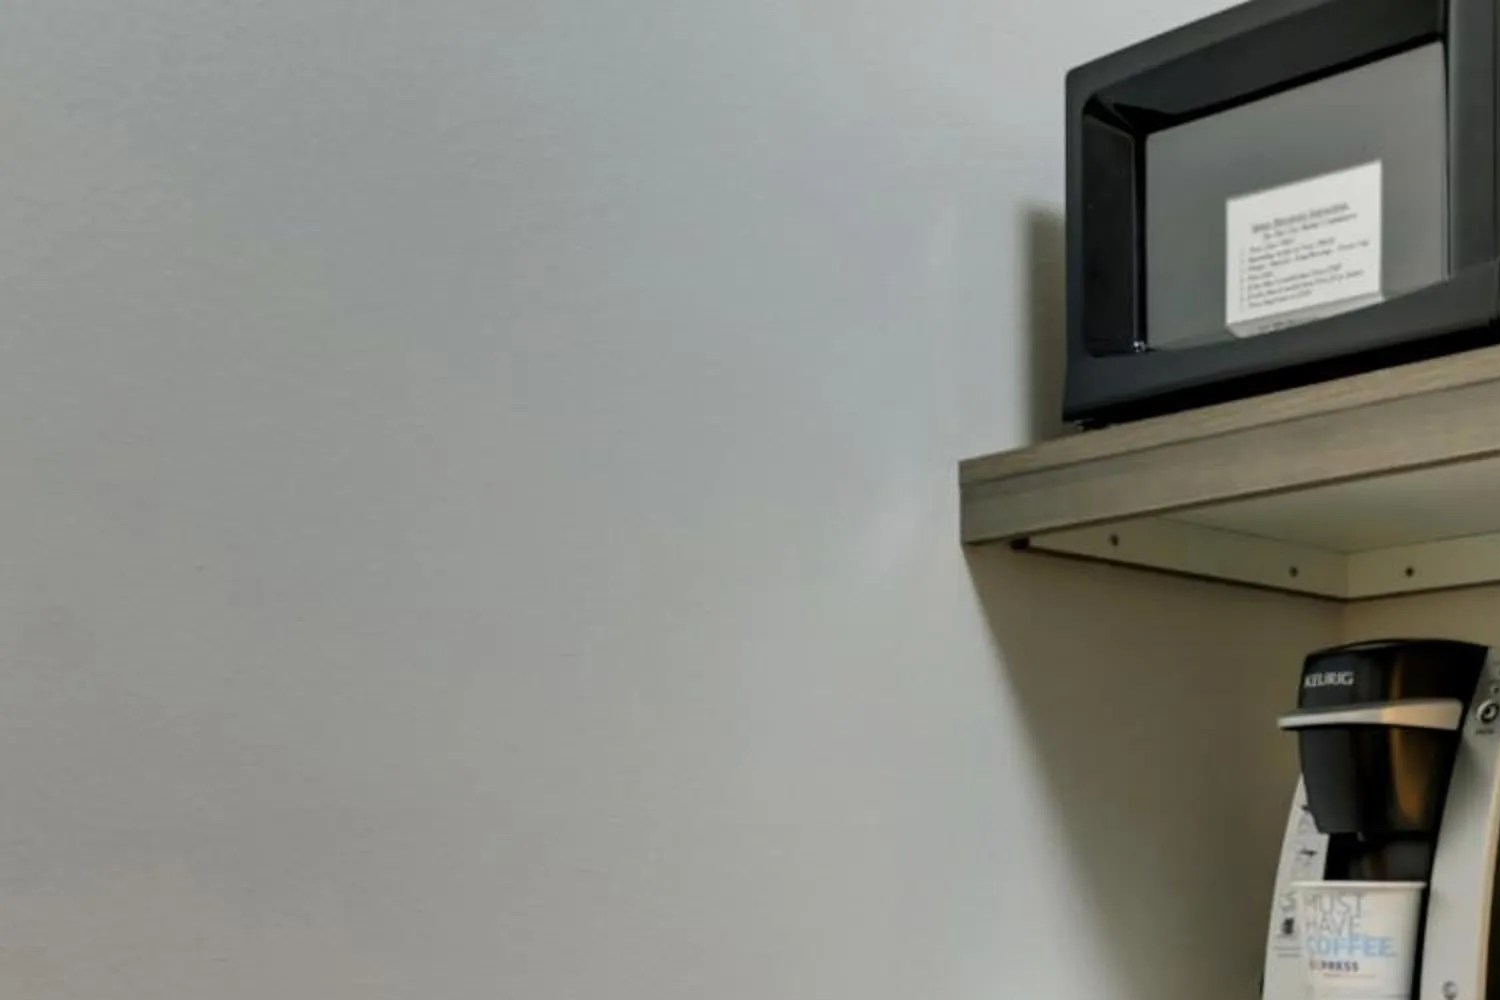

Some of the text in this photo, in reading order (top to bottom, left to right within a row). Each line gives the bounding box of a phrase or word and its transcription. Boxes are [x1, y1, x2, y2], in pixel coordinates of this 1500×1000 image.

[1304, 671, 1355, 688] KEURIG
[1303, 892, 1365, 914] MUST
[1305, 914, 1362, 935] HAVE
